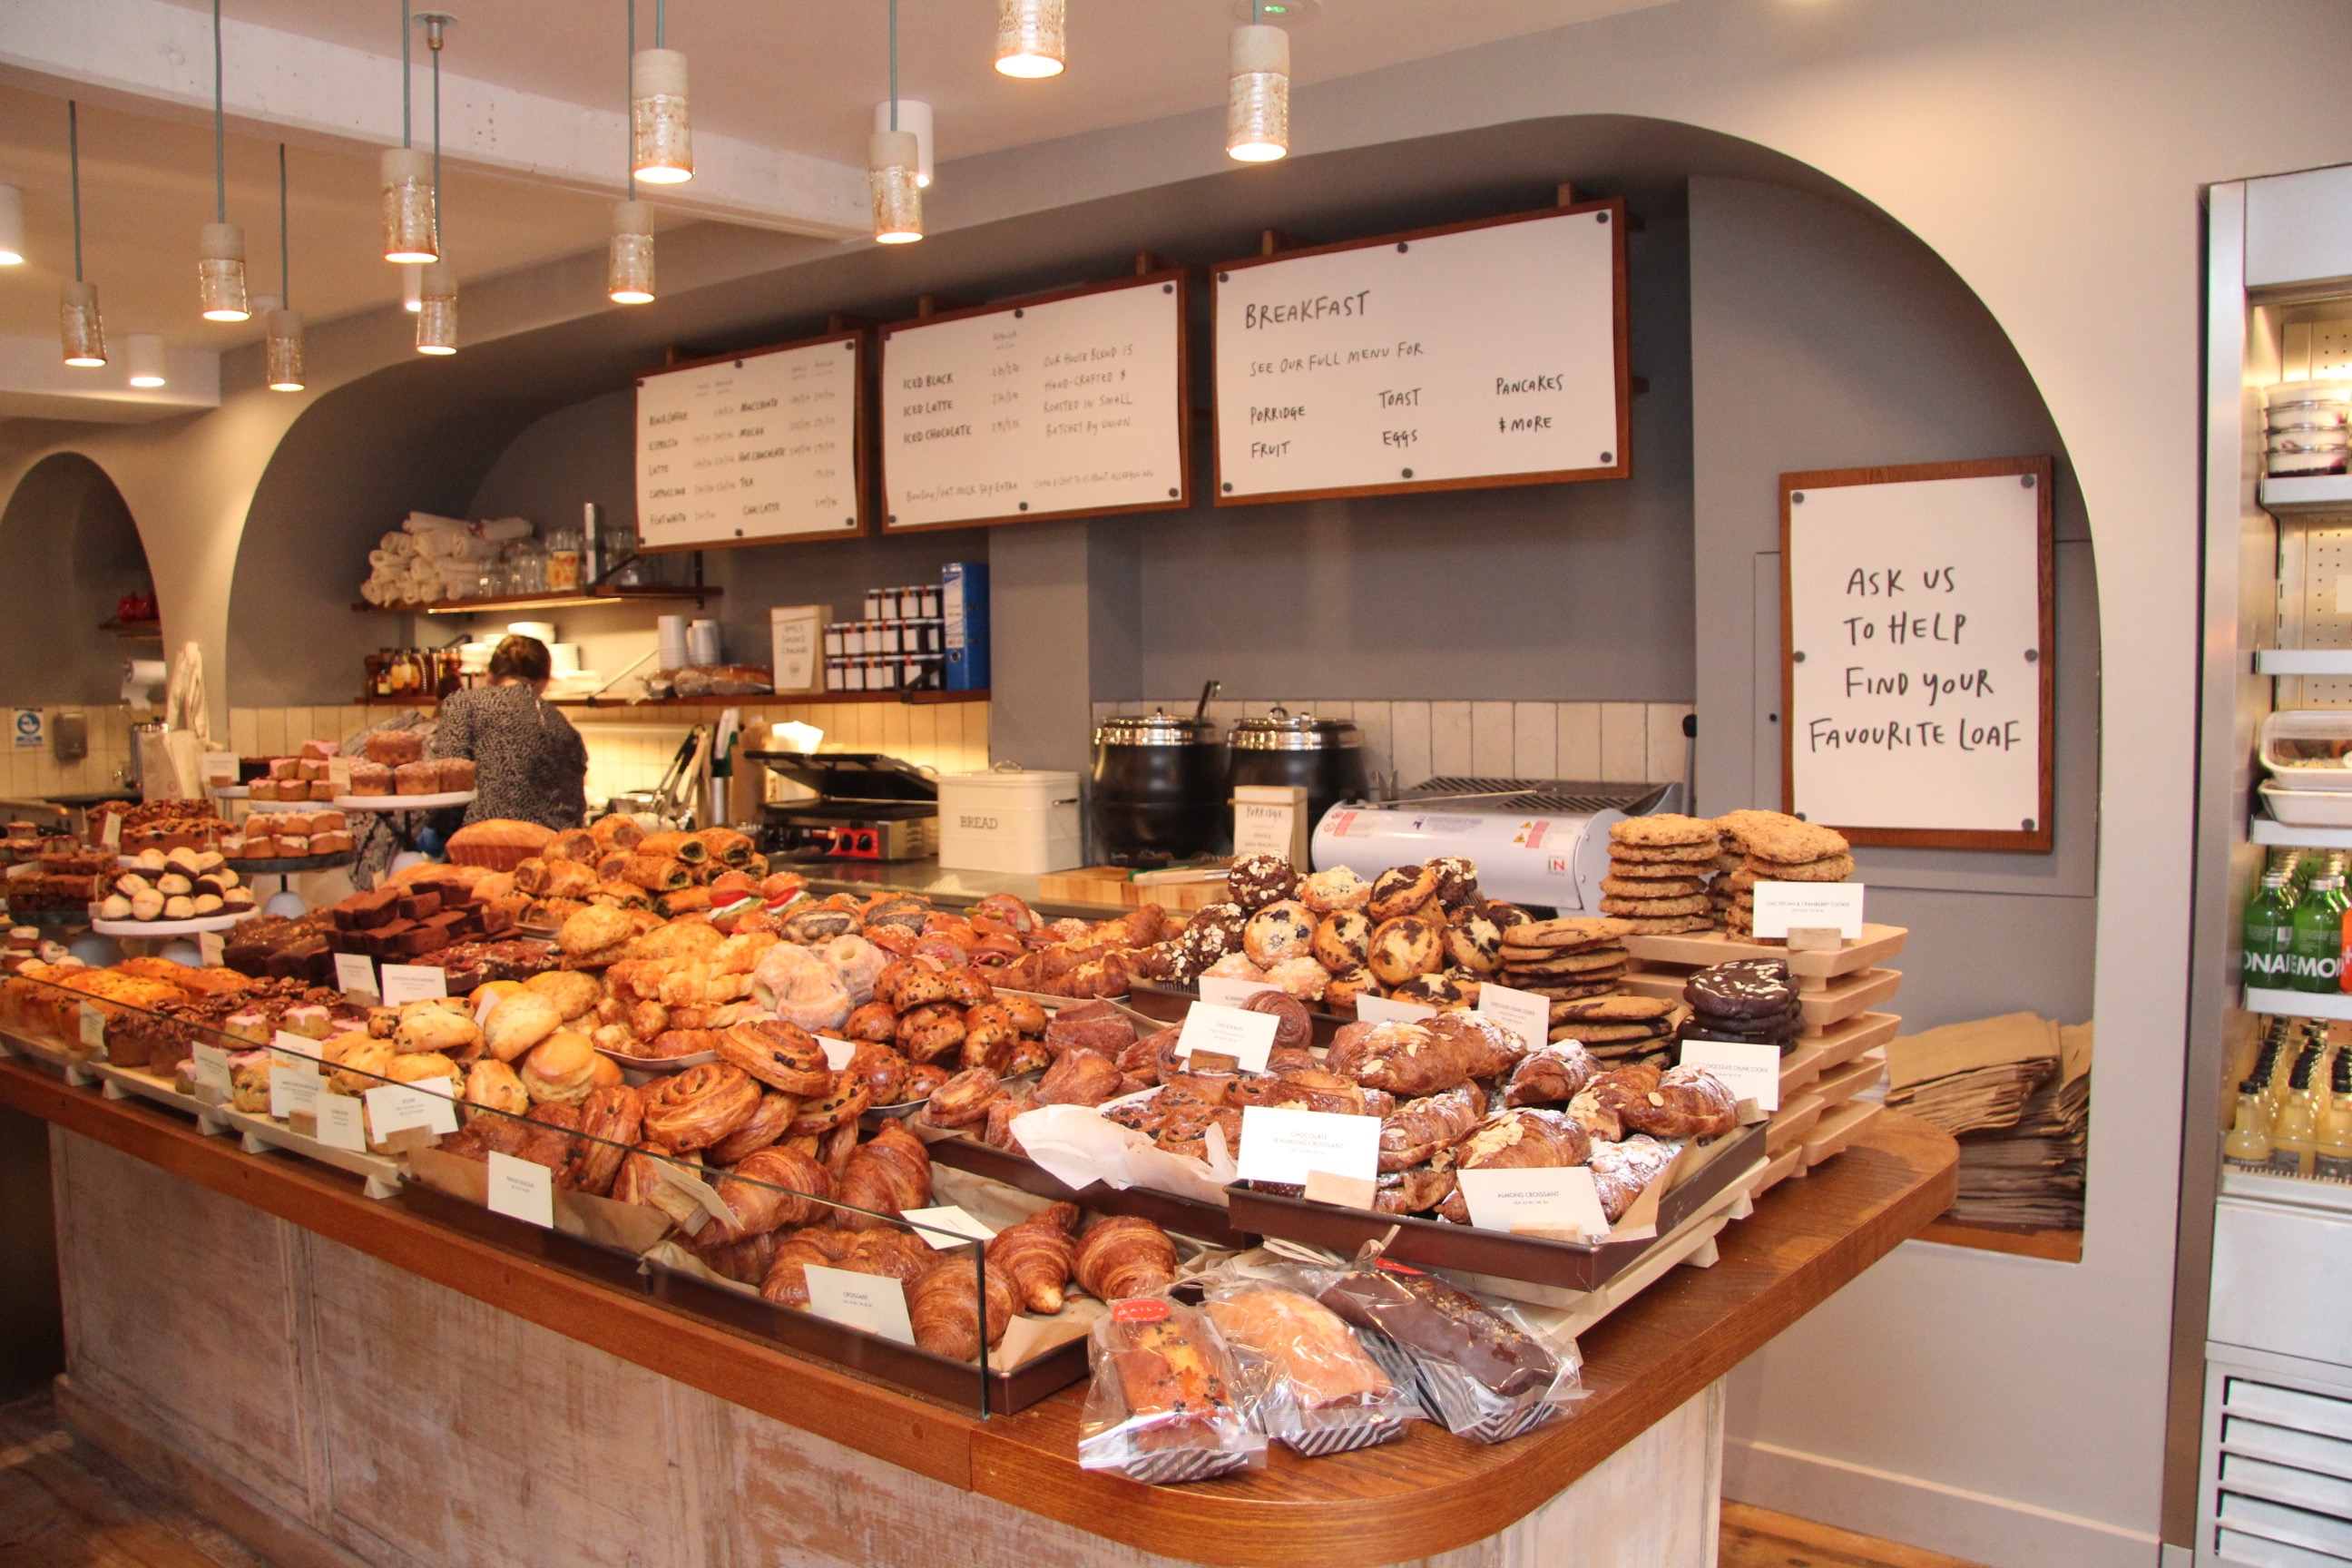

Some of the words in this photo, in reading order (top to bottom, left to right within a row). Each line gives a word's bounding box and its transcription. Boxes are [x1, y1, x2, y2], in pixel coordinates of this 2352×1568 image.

[1246, 290, 1370, 329] BREAKFAST
[1091, 347, 1117, 361] BLEND
[1123, 343, 1133, 357] IS
[1250, 360, 1274, 377] SEE
[1280, 358, 1304, 373] OUR
[1308, 353, 1340, 371] FULL
[1348, 347, 1390, 364] MENU
[1397, 341, 1424, 358] FOR
[903, 377, 923, 389] ICED
[926, 372, 955, 387] BLACK
[1495, 374, 1563, 396] PANCAKES
[903, 404, 923, 416] ICED
[926, 399, 953, 414] LATTE
[1044, 399, 1080, 414] ROASTED
[1083, 399, 1094, 409] IN
[1099, 392, 1133, 407] SMALL
[1378, 387, 1421, 409] TOAST
[1045, 421, 1083, 436] BATCHES
[1102, 415, 1131, 429] UNION
[1250, 406, 1306, 426] PORRIDGE
[1511, 416, 1553, 431] MORE
[903, 429, 923, 444] ICED
[925, 424, 972, 440] CHOCOLATE
[1383, 429, 1418, 447] EGGS
[1250, 441, 1290, 458] FRUIT
[649, 464, 670, 476] LATTE
[740, 475, 755, 488] TEA
[1847, 567, 1905, 597] ASK
[1924, 566, 1955, 593] US
[1844, 616, 1874, 646] TO
[1887, 611, 1966, 645] HELP
[1847, 667, 1908, 698] FIND
[1808, 718, 1945, 752] FAVOURITE
[1960, 719, 2022, 751] LOAF
[960, 816, 998, 830] BREAD
[1279, 1138, 1307, 1146] ALMOND
[1308, 1140, 1344, 1150] CROISSANT
[1290, 1131, 1328, 1141] CHOCOLATE
[1524, 1191, 1560, 1199] CROISSANT
